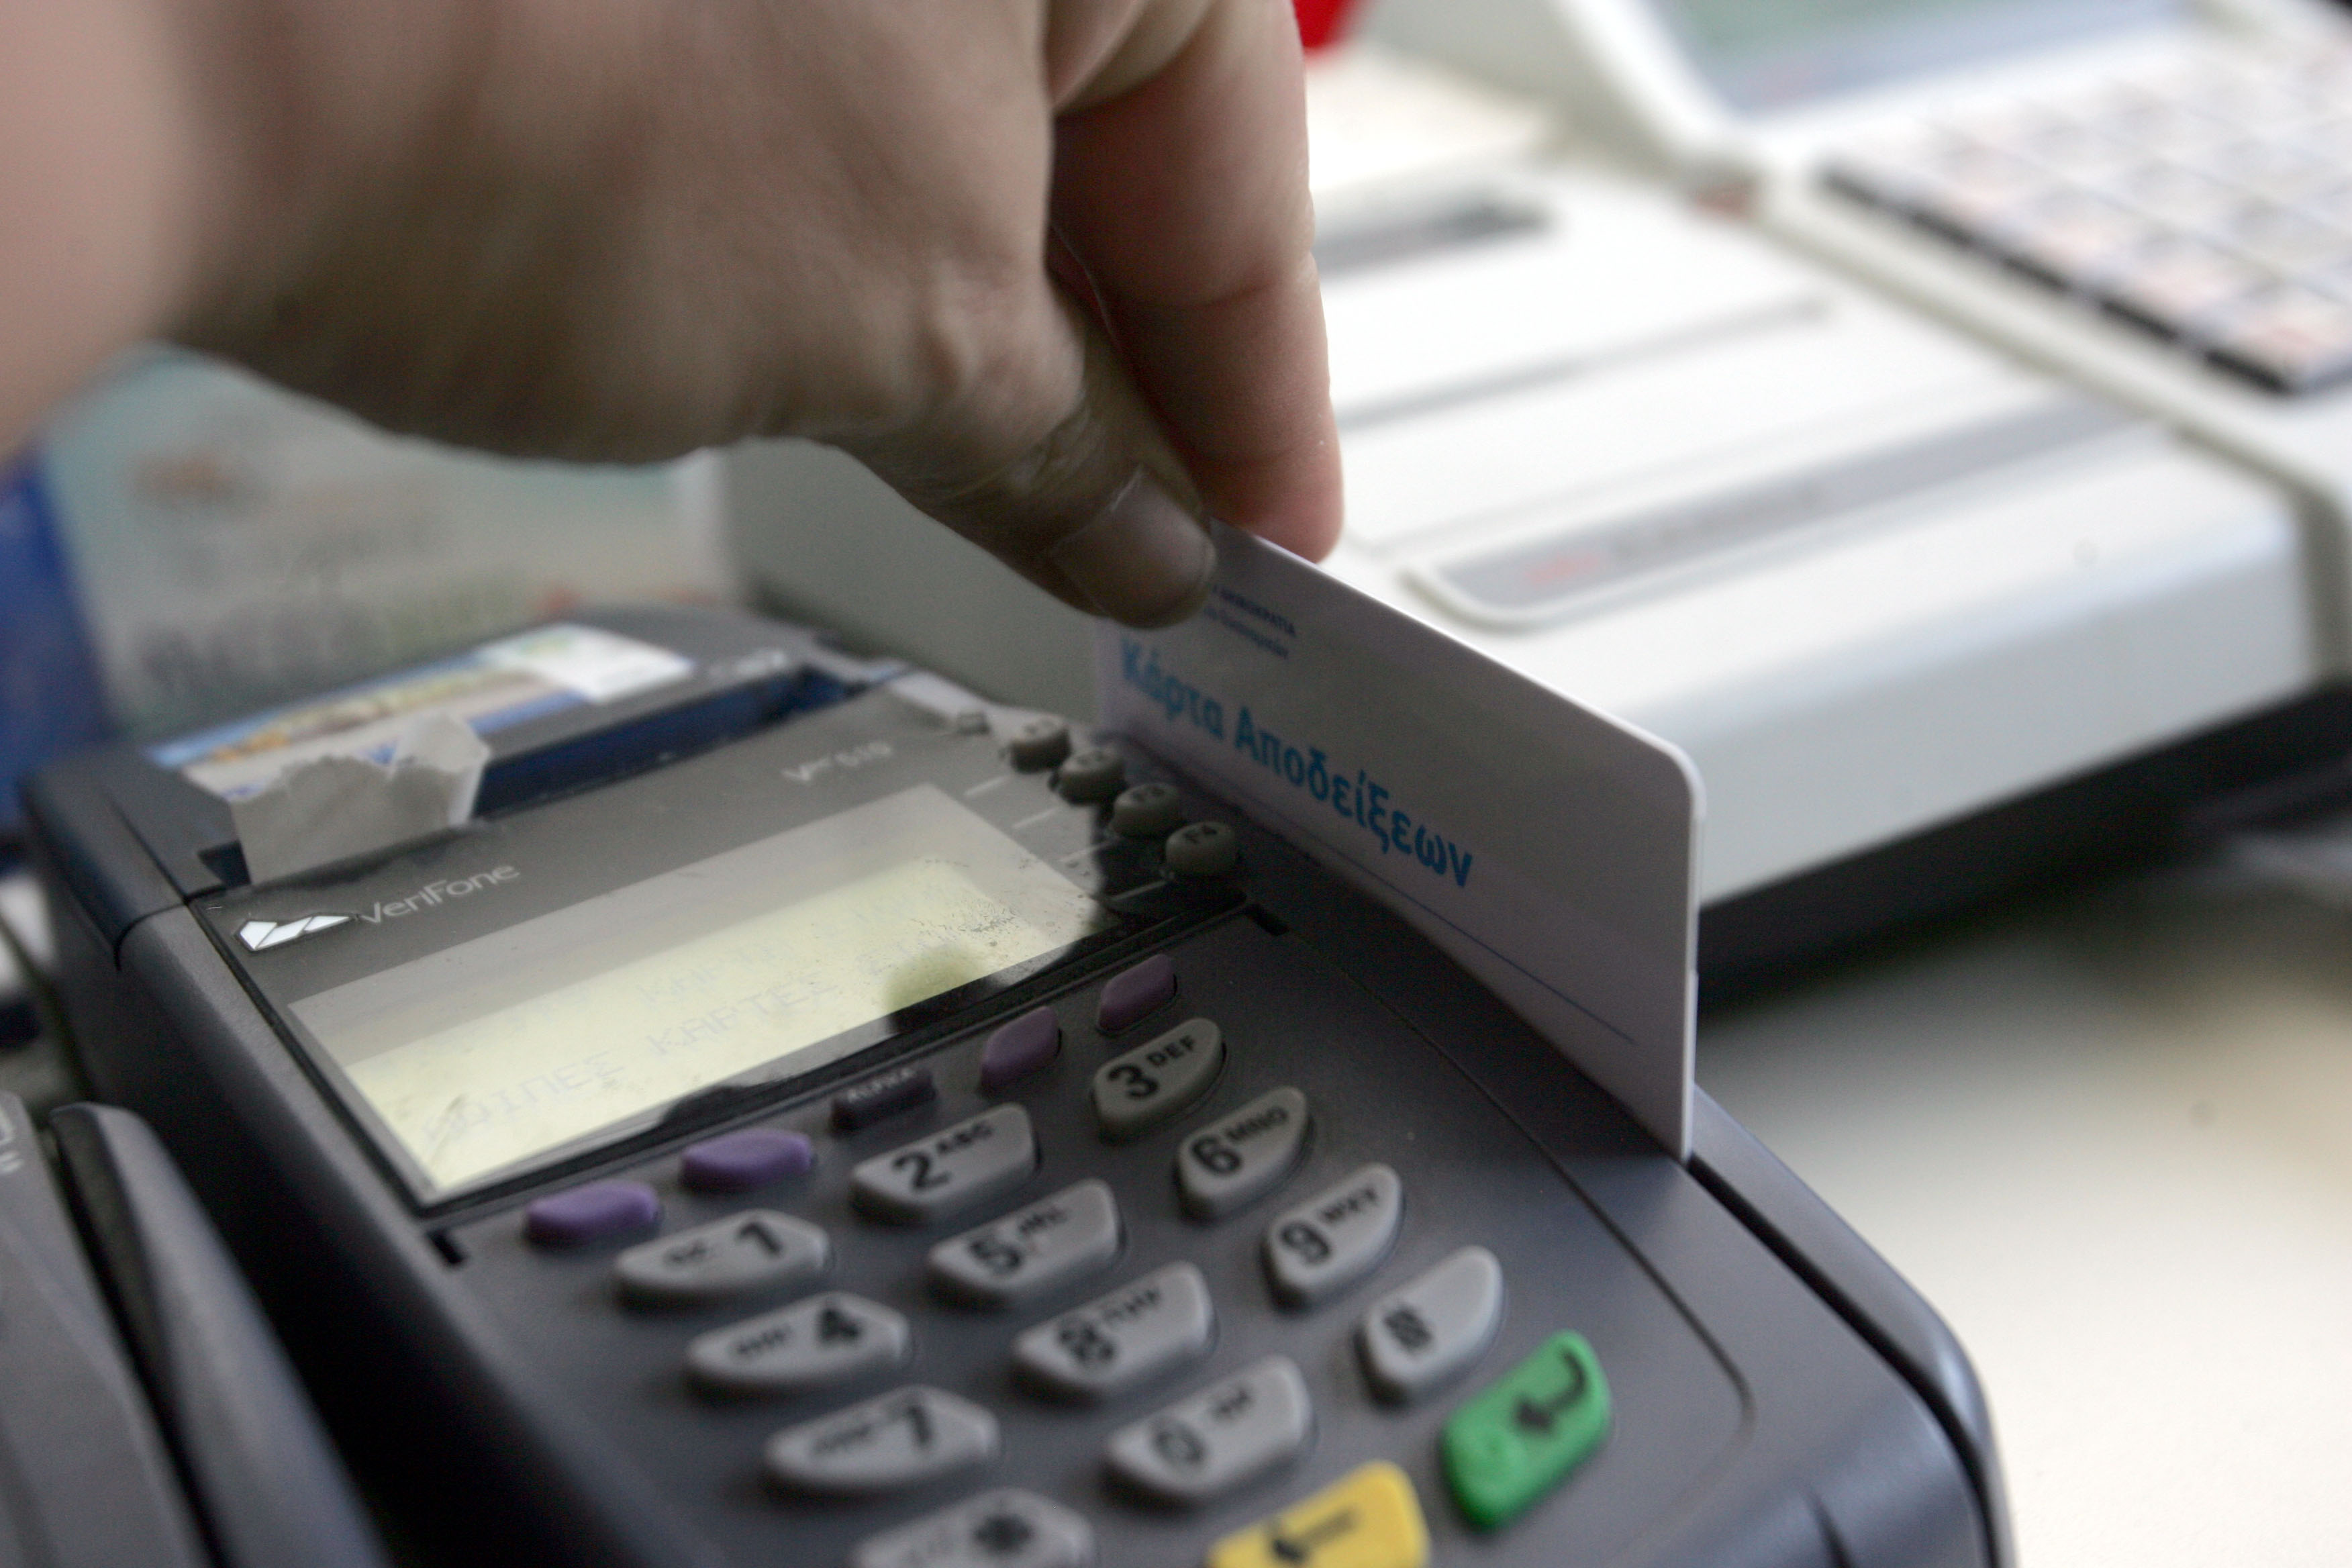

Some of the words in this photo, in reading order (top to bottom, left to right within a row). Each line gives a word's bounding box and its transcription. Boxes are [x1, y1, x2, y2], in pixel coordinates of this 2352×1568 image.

[1120, 638, 1224, 740] Κάρτα
[1235, 706, 1473, 888] Αποδείξεων
[358, 863, 522, 925] VeriFone
[1110, 1063, 1159, 1100] 3
[1145, 1035, 1197, 1067] DEF
[892, 1150, 950, 1191] 2
[1191, 1136, 1244, 1175] 6
[736, 1221, 783, 1257] 1
[969, 1233, 1022, 1275] 5
[1279, 1220, 1332, 1265] 9
[816, 1306, 865, 1345] 4
